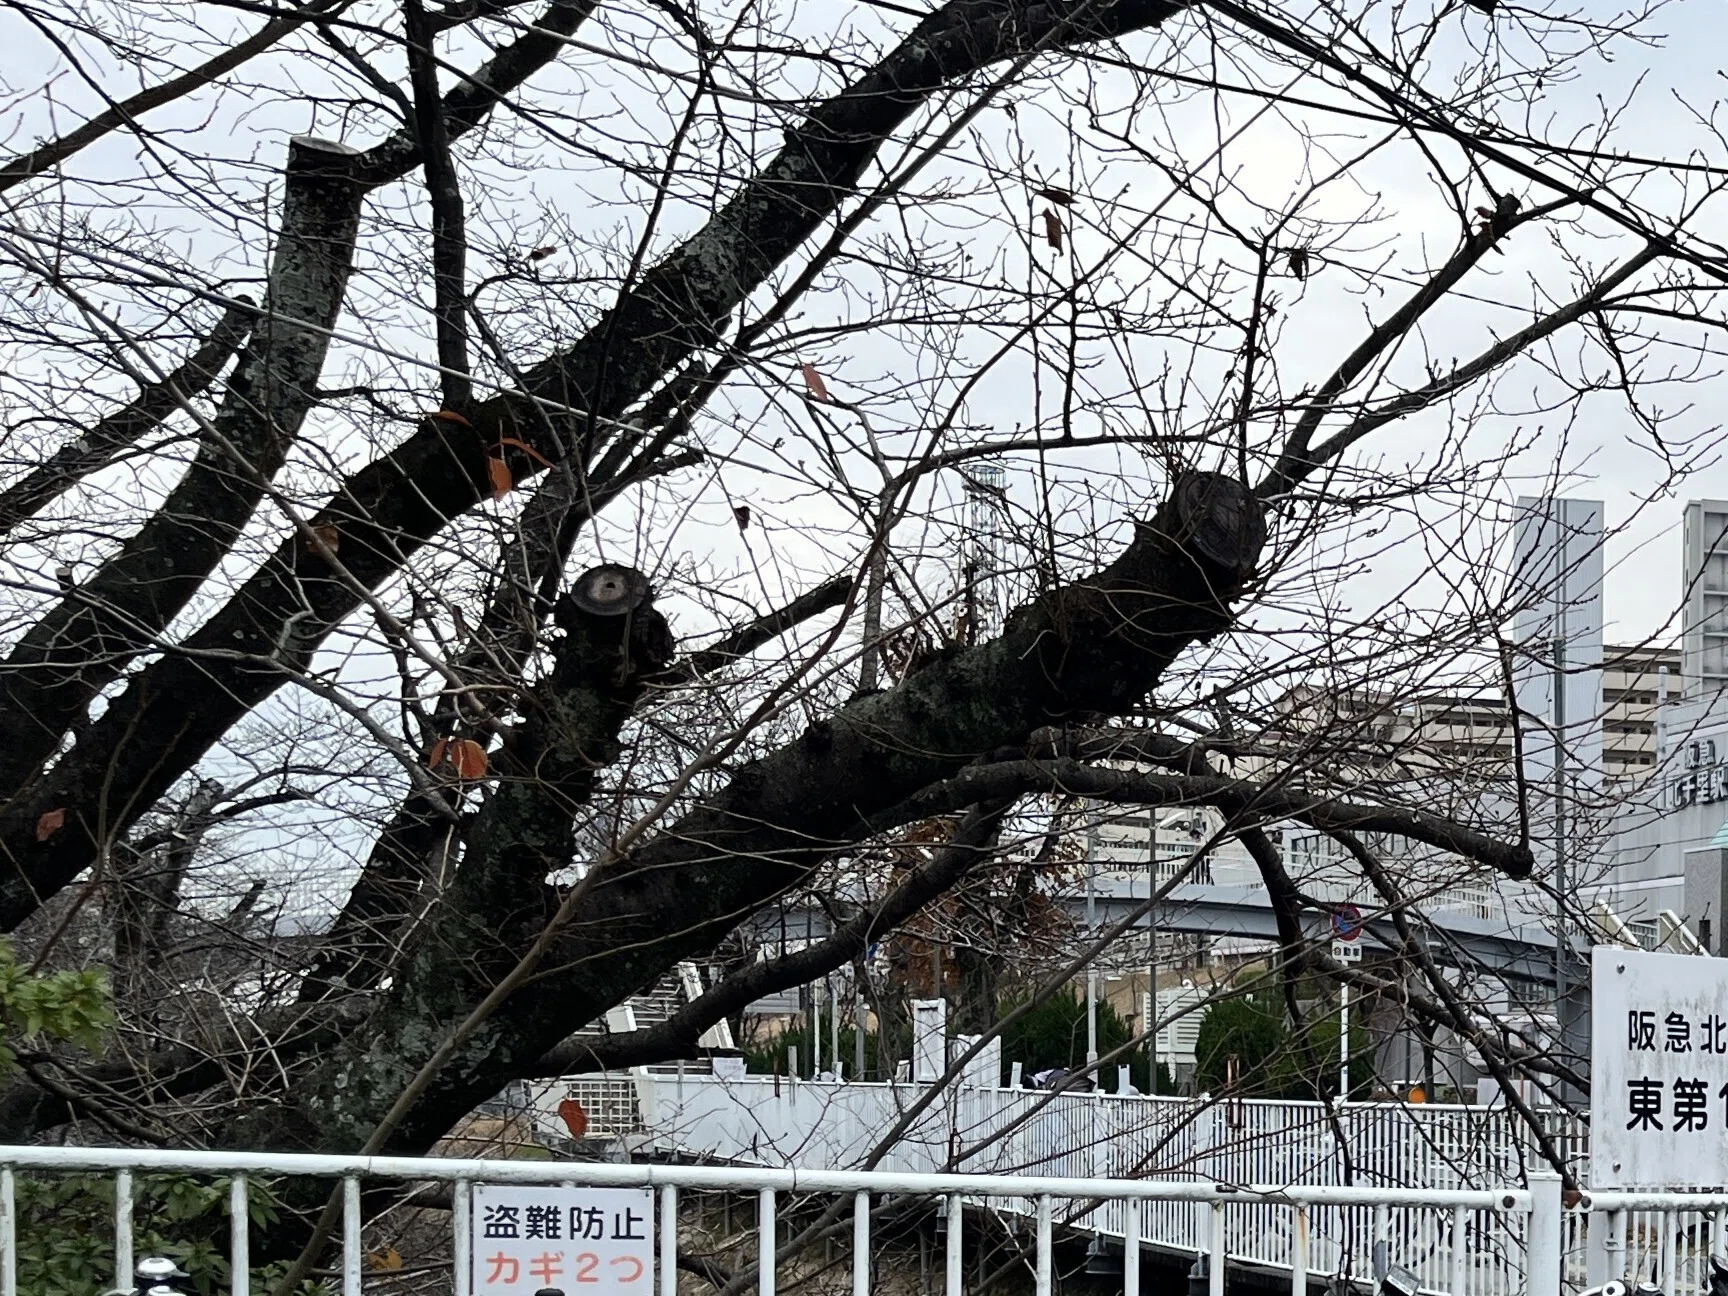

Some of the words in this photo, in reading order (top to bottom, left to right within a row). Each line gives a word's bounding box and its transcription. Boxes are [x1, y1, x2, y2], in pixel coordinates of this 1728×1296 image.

[483, 1205, 645, 1240] 盗難防止
[486, 1251, 644, 1285] カギ2つ
